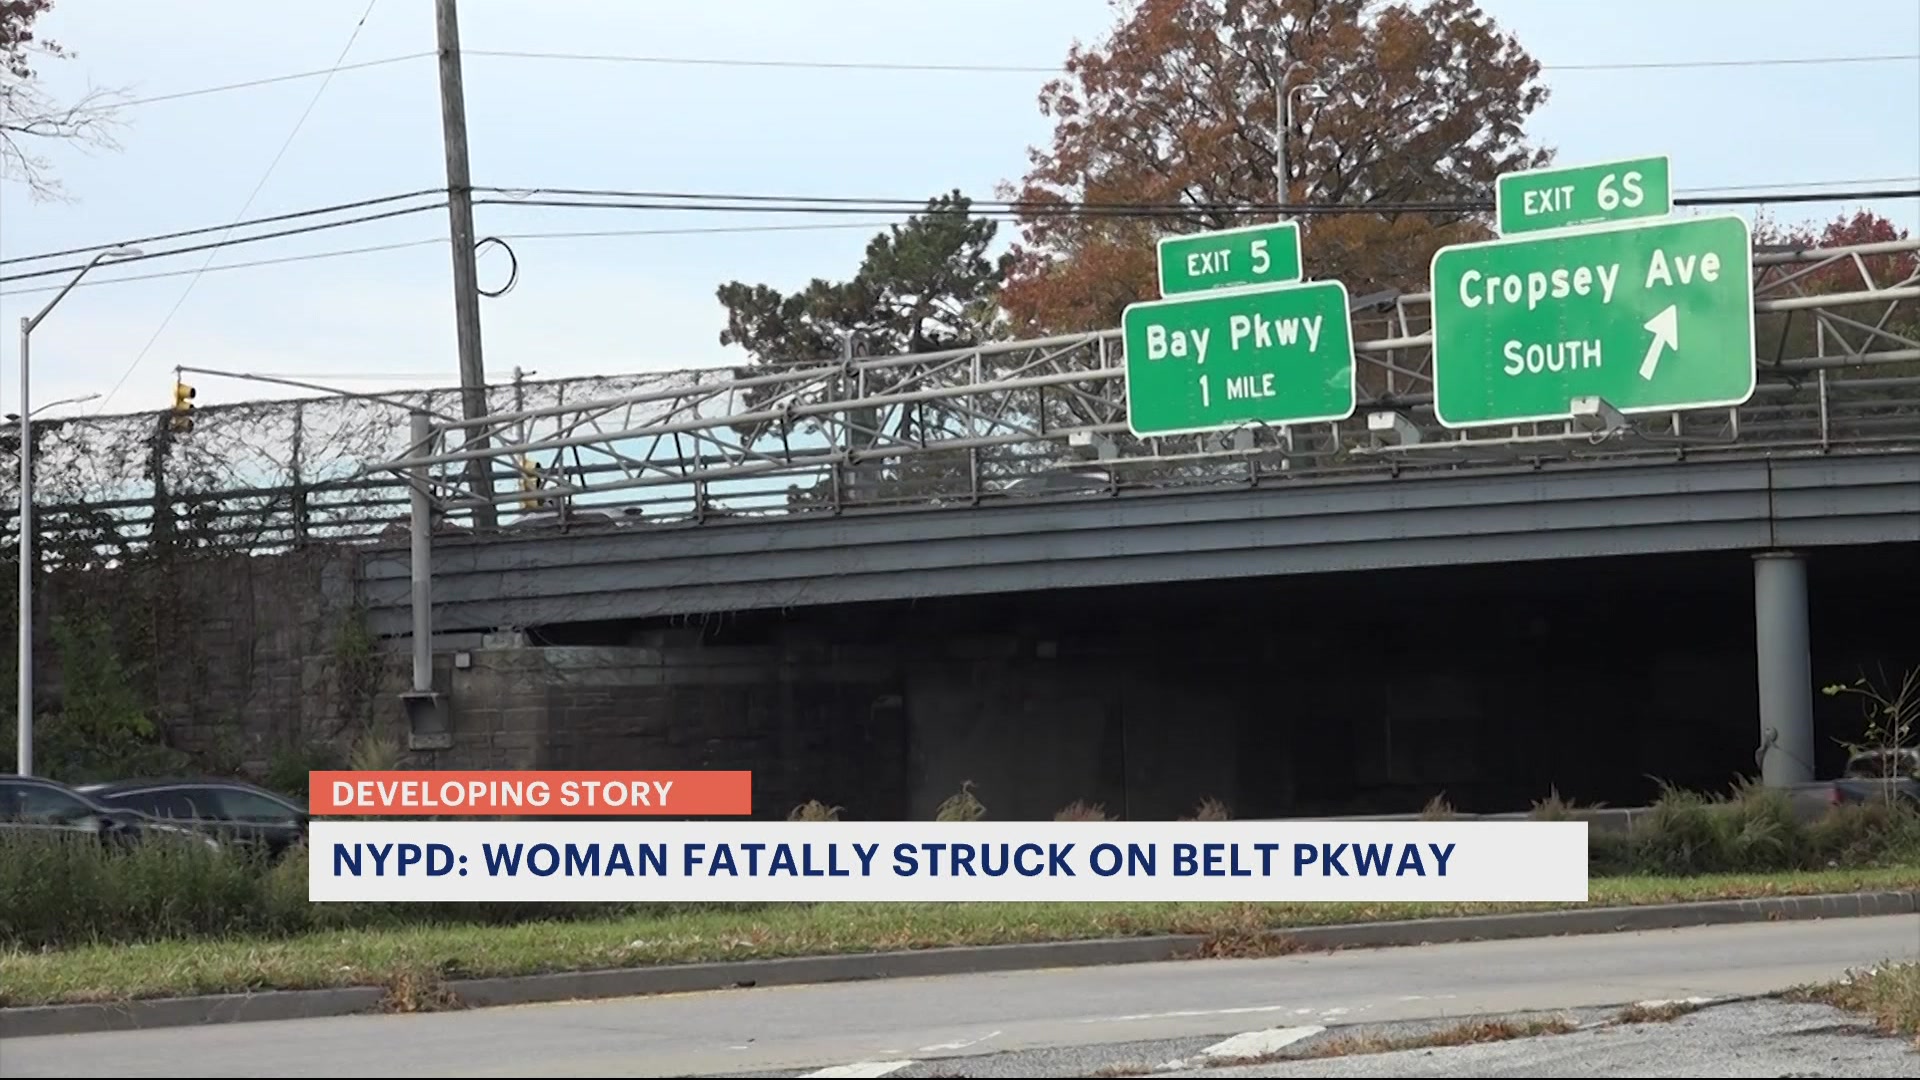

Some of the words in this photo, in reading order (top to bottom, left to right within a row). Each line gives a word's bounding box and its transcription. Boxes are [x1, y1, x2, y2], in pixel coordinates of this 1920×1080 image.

[1523, 185, 1575, 216] EXIT
[1597, 171, 1645, 211] 6S
[1187, 249, 1231, 276] EXIT
[1251, 239, 1270, 274] 5
[1459, 263, 1620, 311] Cropsey
[1645, 248, 1721, 289] Ave
[1147, 324, 1210, 364] Bay
[1230, 313, 1323, 353] Pkwy
[1503, 339, 1602, 376] SOUTH
[1199, 375, 1209, 407] 1
[1227, 373, 1276, 400] MILE
